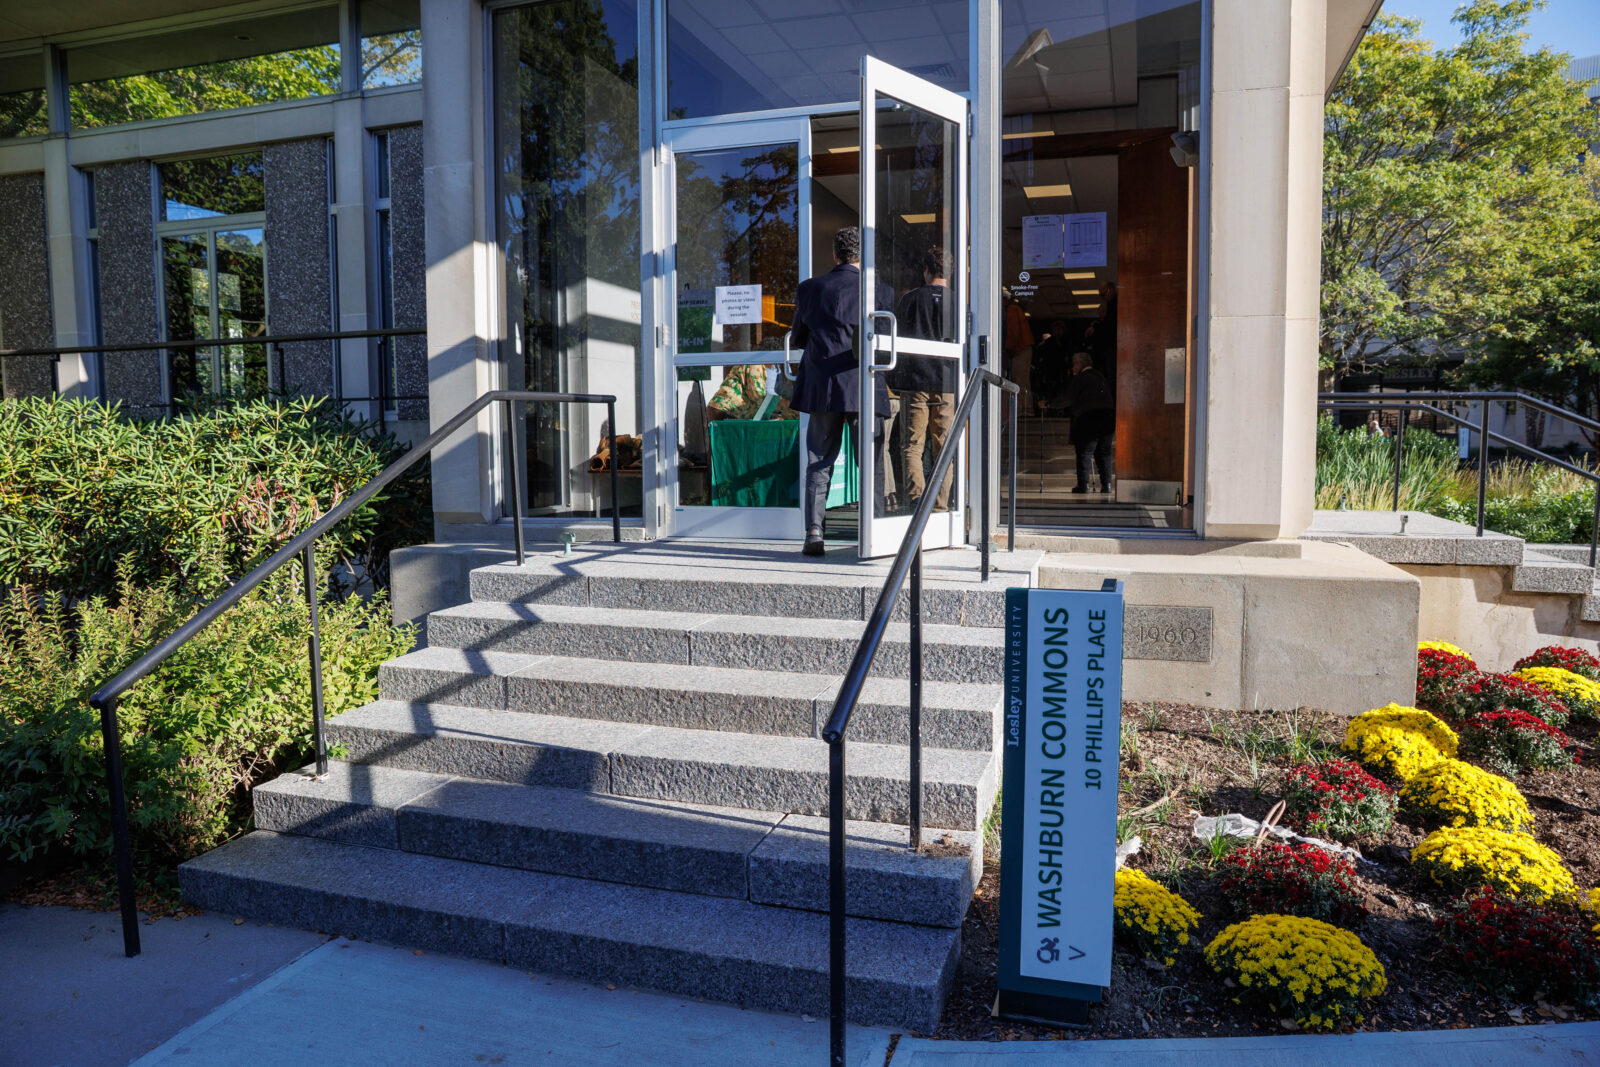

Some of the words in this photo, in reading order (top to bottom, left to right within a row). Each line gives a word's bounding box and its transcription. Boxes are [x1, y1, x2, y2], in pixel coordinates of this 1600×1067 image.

[1012, 606, 1022, 693] UNIVERSITY
[1087, 609, 1106, 671] PLACE
[1140, 625, 1196, 646] 1960
[1041, 607, 1069, 759] COMMONS
[1085, 677, 1104, 763] PHILLIPS
[1007, 695, 1023, 748] Lesley
[1085, 768, 1102, 790] 10
[1036, 769, 1065, 928] WASHBURN
